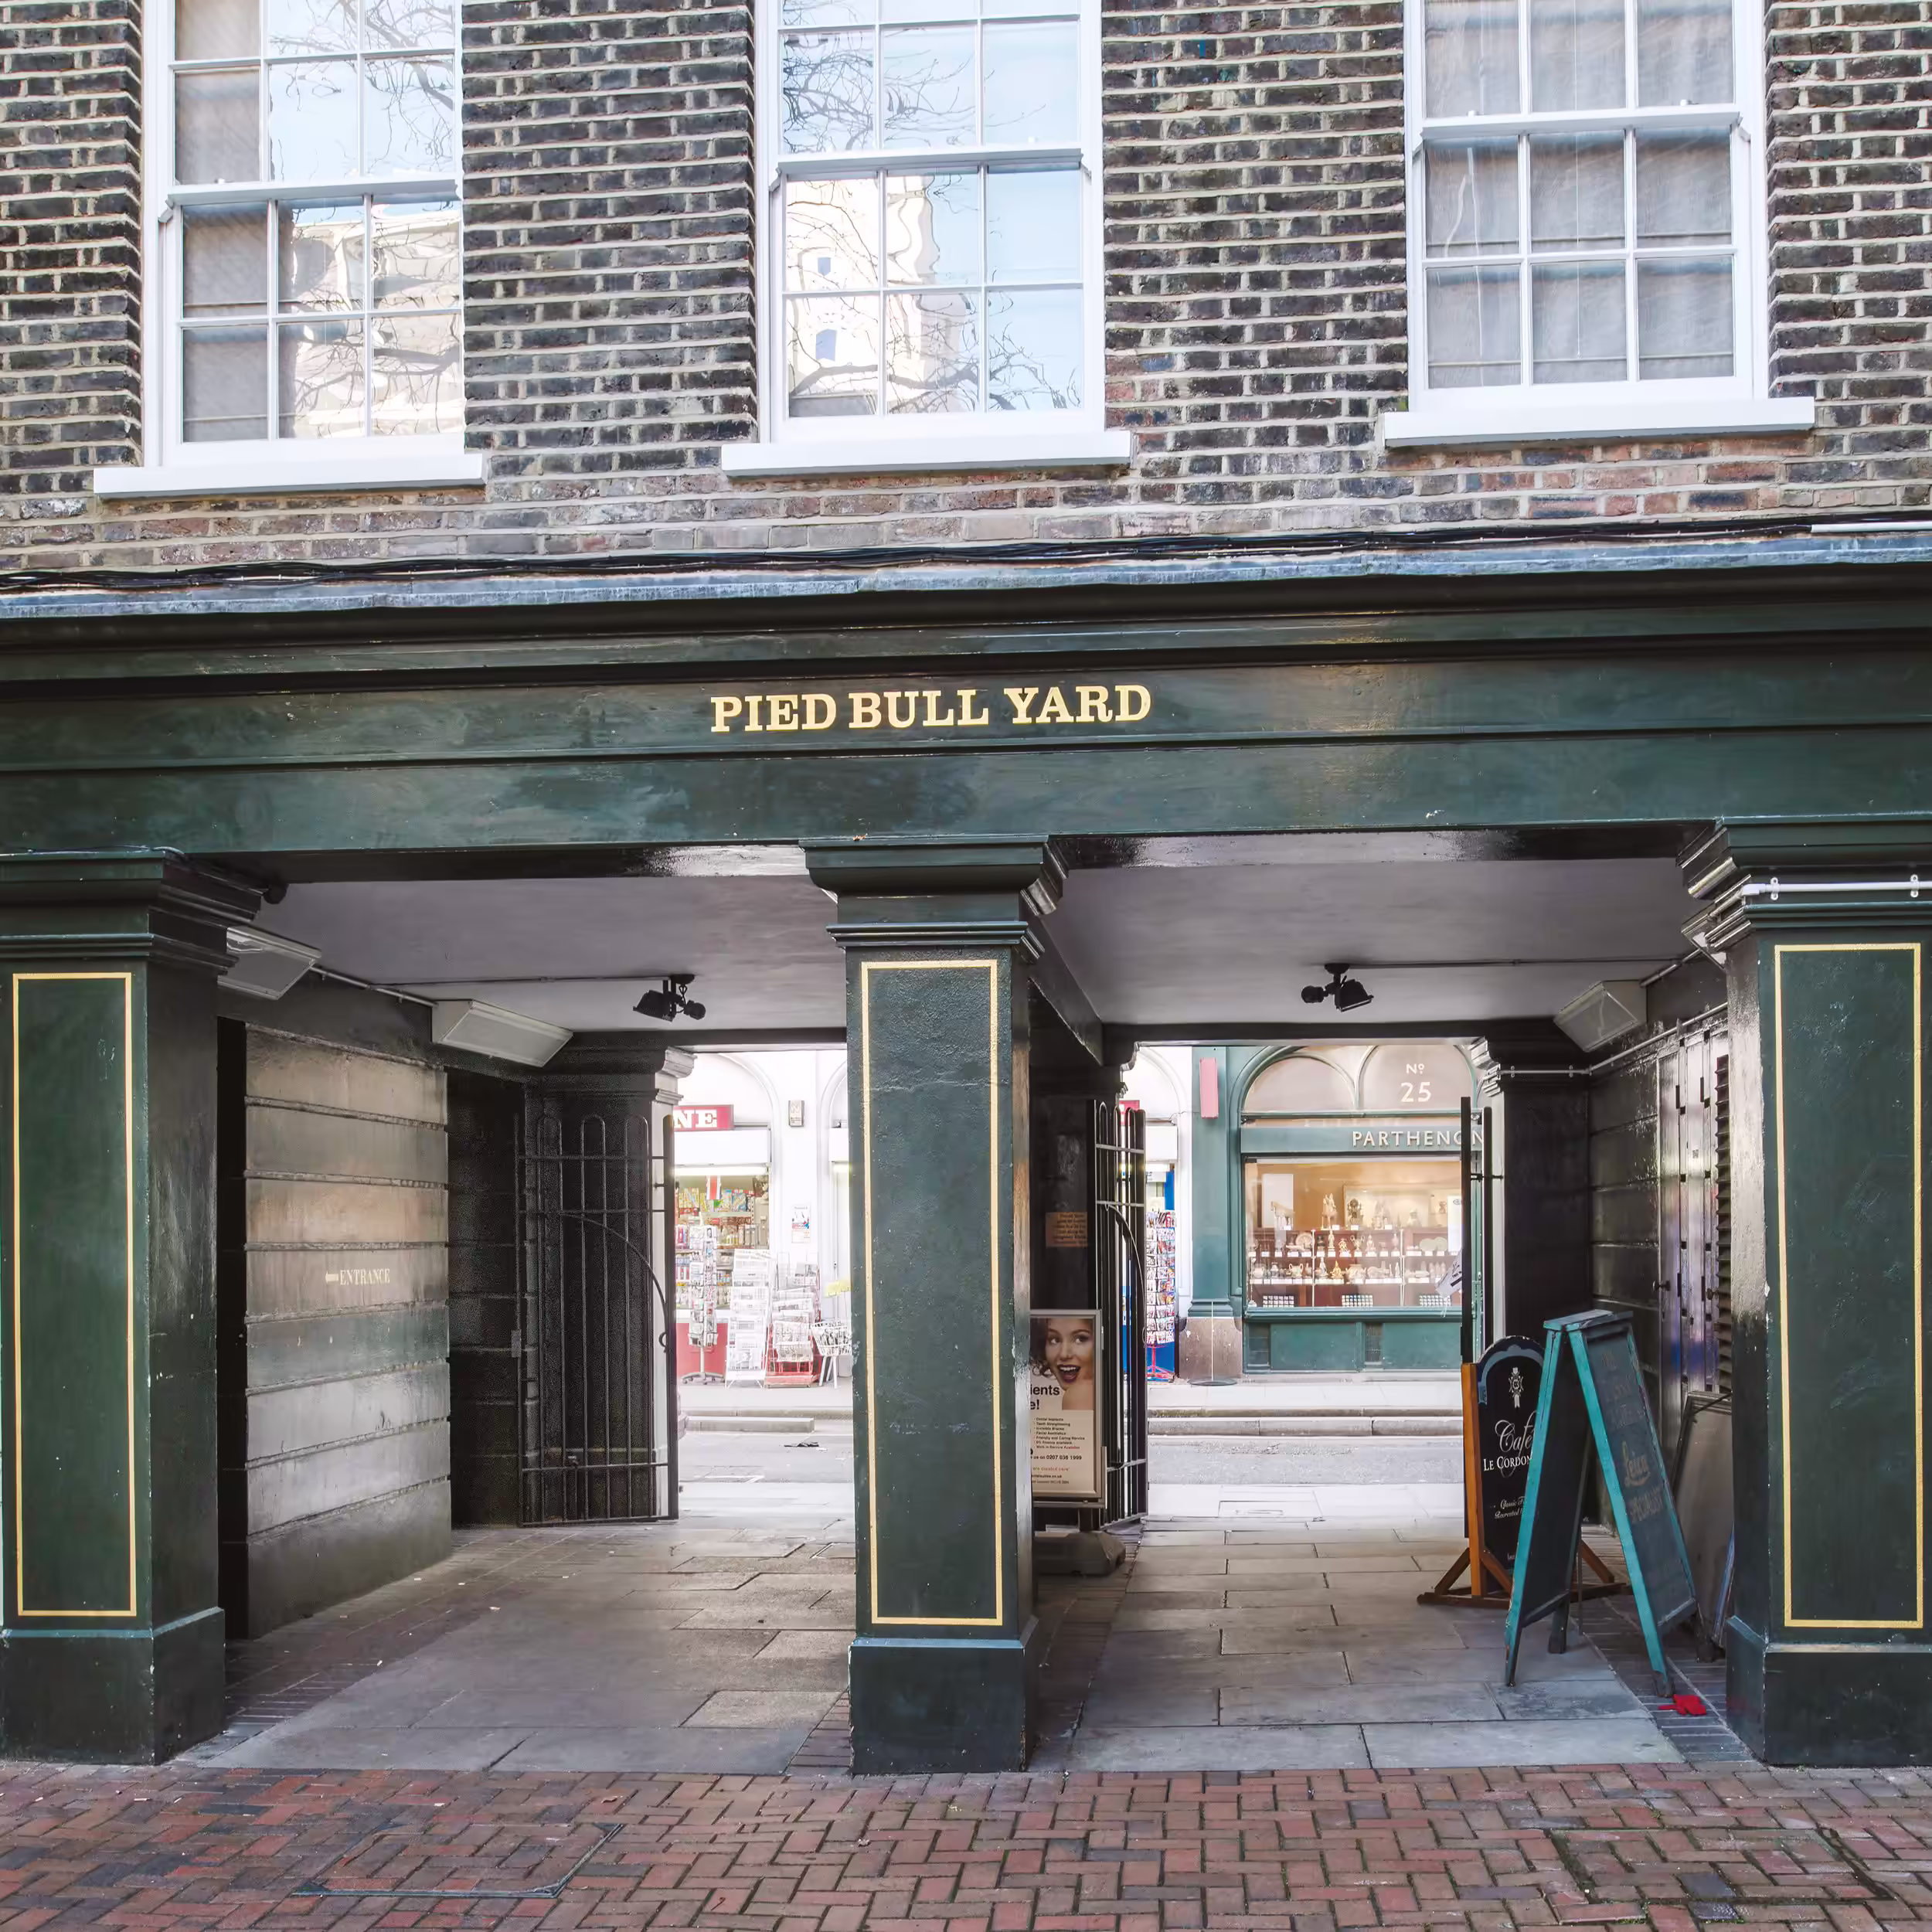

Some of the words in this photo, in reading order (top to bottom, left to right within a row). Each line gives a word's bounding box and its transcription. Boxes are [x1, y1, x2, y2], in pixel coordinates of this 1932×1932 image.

[710, 694, 837, 733] PIED
[848, 689, 988, 729] BULL
[1004, 684, 1151, 725] YARD
[1400, 1082, 1431, 1103] 25
[340, 1268, 390, 1286] ENTRANCE
